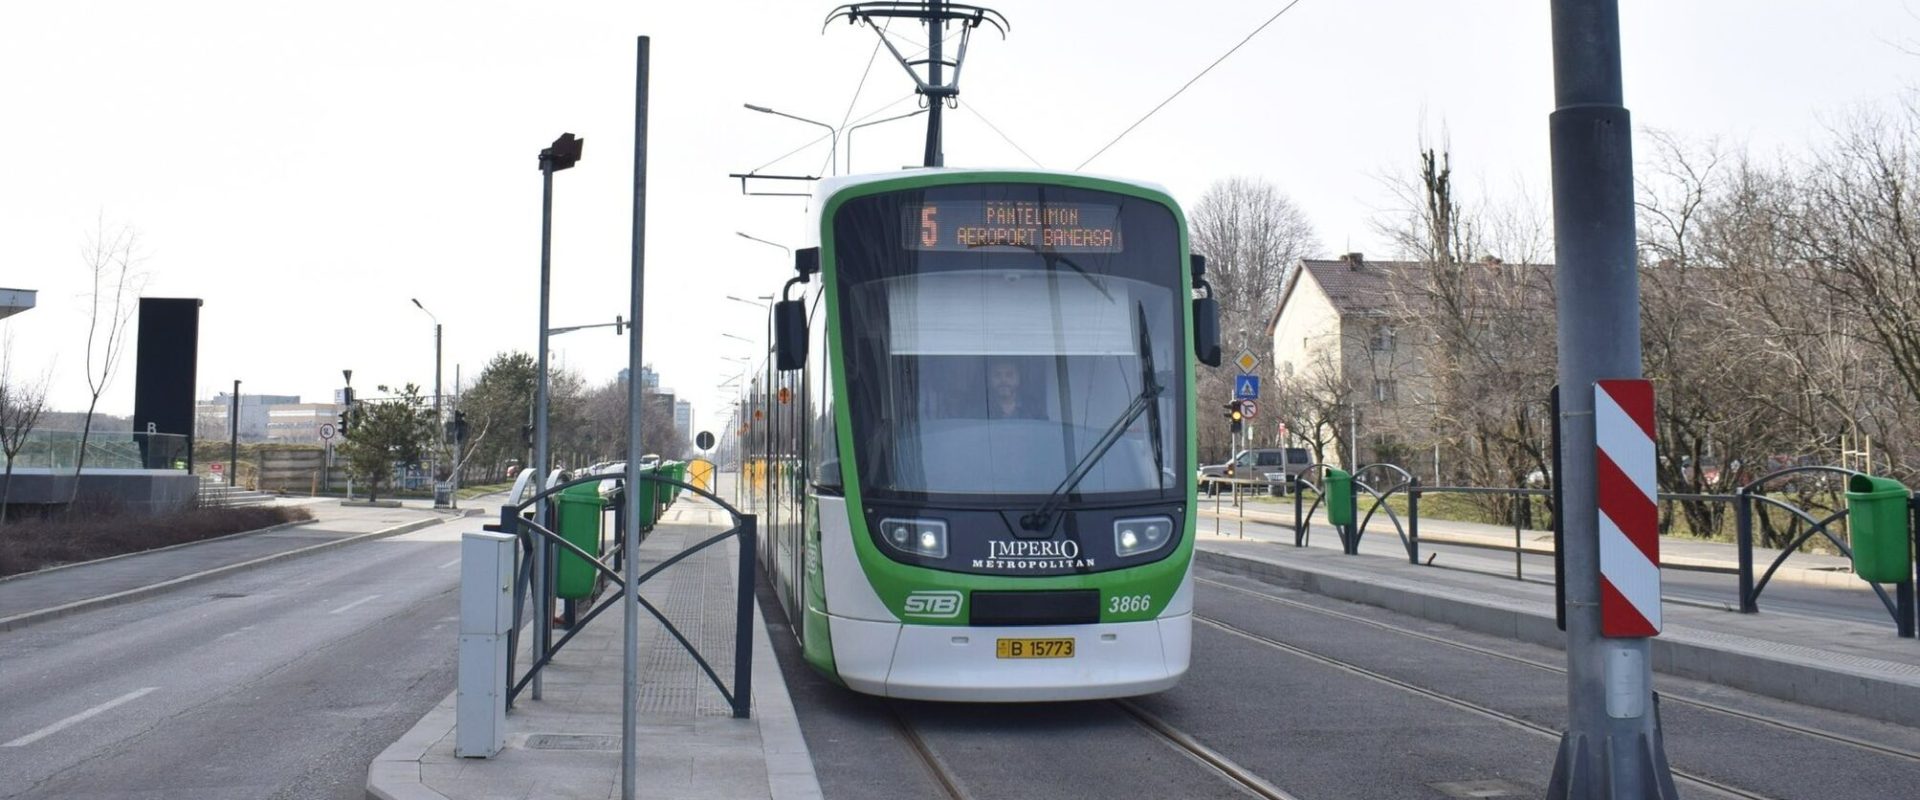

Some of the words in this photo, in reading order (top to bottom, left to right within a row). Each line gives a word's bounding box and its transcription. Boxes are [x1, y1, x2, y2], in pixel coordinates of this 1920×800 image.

[987, 207, 1079, 225] PANTELIMON
[921, 206, 938, 247] 5
[957, 227, 1037, 246] AEROPORT
[1043, 228, 1113, 247] BANEASA
[147, 422, 157, 435] B
[988, 540, 1079, 559] IMPERIO
[972, 559, 1095, 569] METROPOLITAN
[904, 595, 957, 612] STB
[1108, 594, 1151, 613] 3866
[1011, 641, 1023, 656] B
[1030, 641, 1073, 656] 15773
